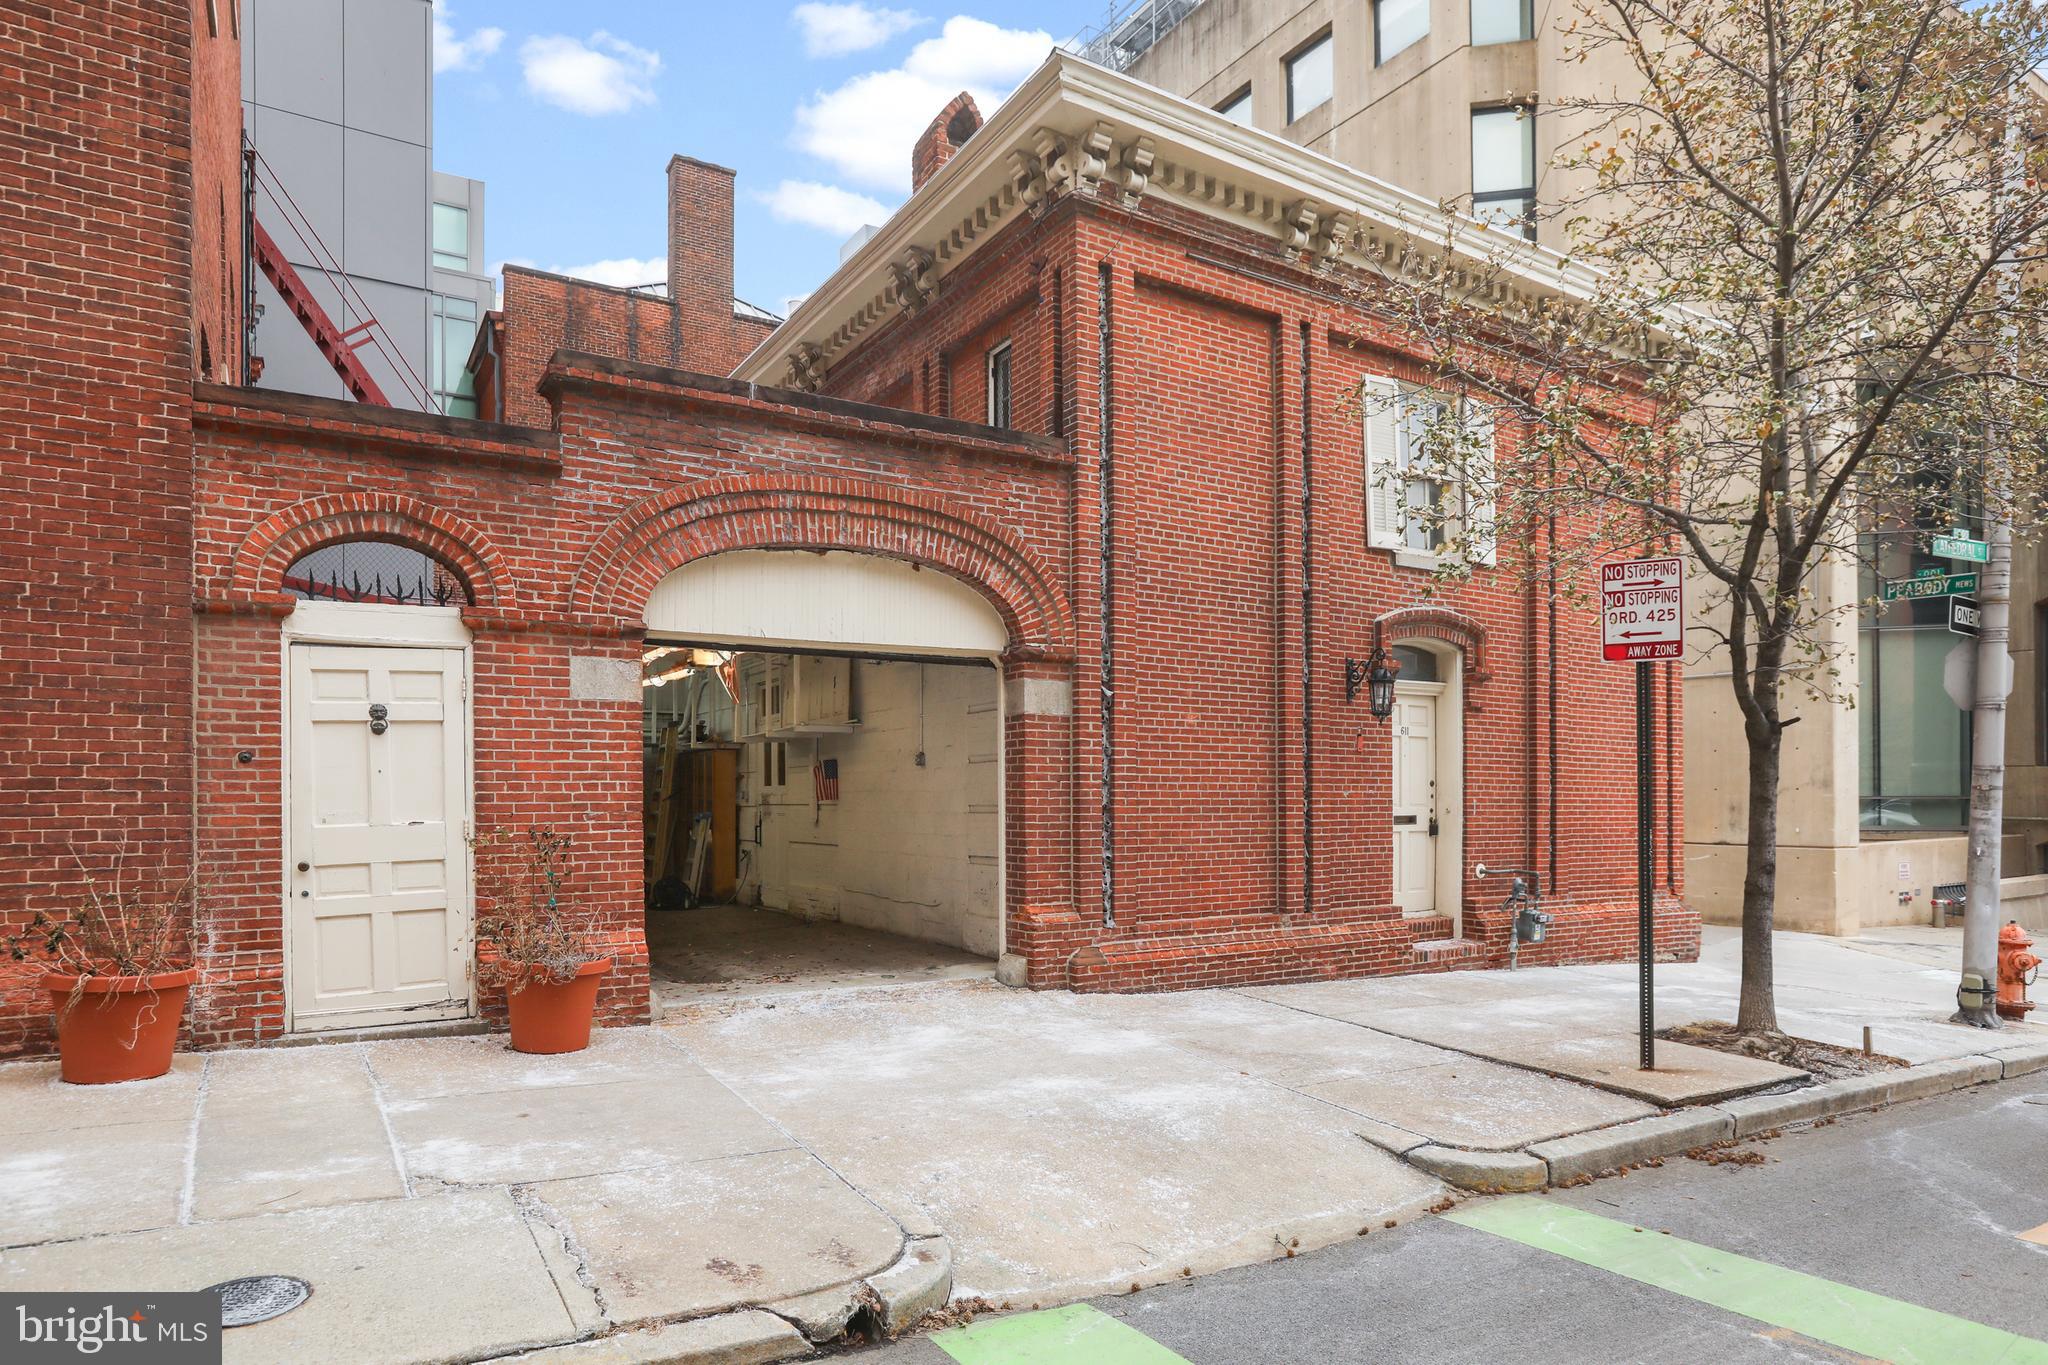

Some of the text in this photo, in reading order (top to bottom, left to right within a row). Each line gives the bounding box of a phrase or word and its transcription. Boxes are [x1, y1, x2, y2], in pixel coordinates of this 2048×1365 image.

[1605, 562, 1677, 580] NO STOPPING
[1887, 579, 1951, 598] PEABODY
[1605, 590, 1678, 607] NO STOPPING
[1609, 608, 1676, 625] ORD. 425
[1956, 607, 1974, 624] ONE
[1628, 644, 1678, 657] AWAY ZONE
[1400, 726, 1409, 736] 611
